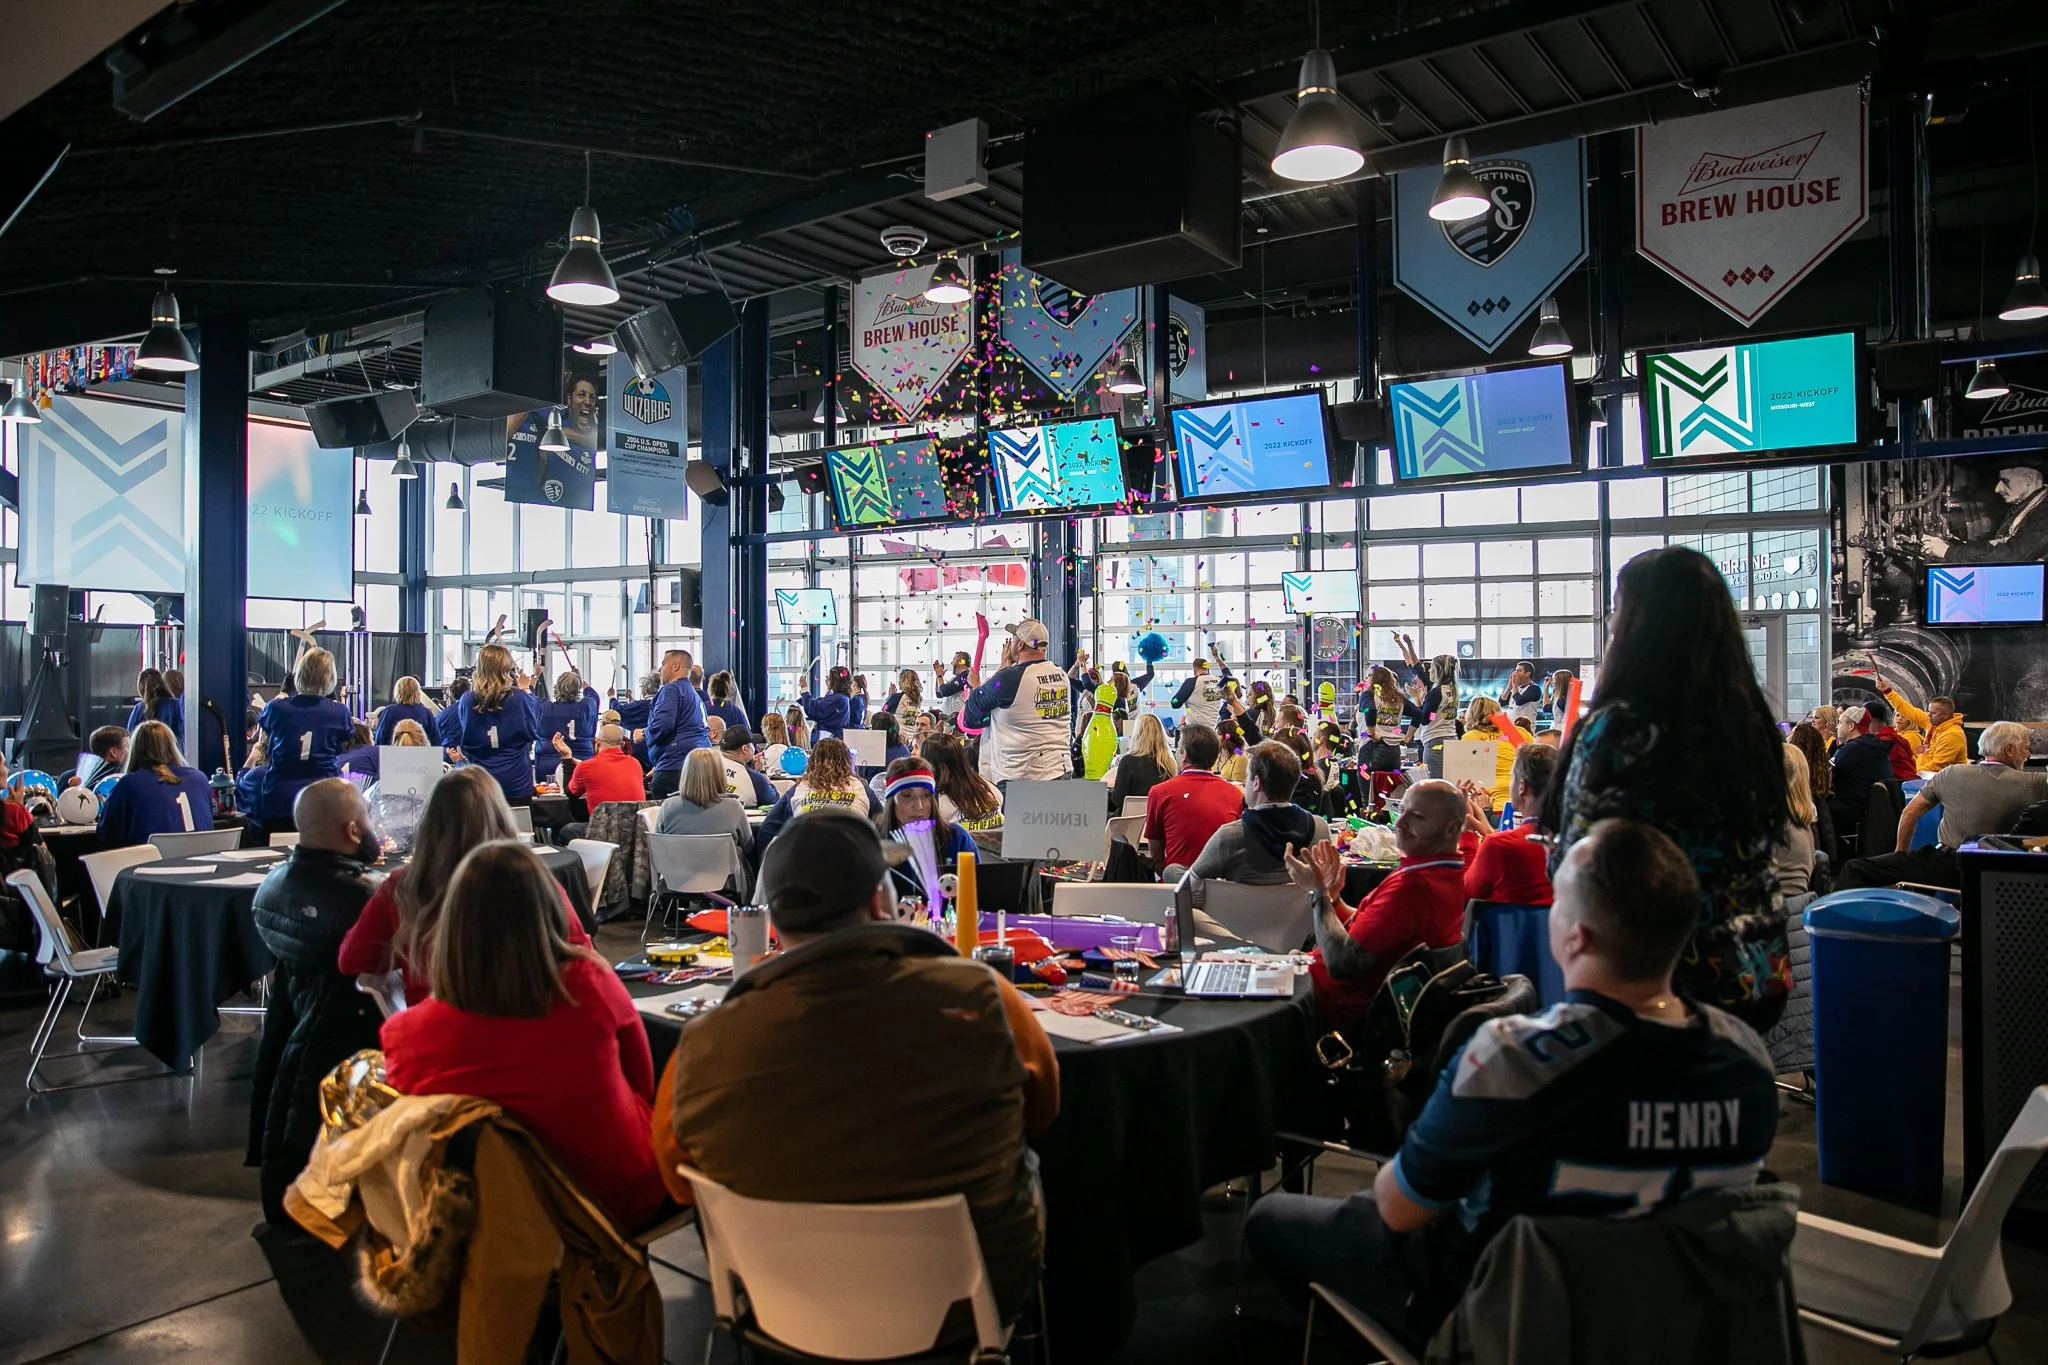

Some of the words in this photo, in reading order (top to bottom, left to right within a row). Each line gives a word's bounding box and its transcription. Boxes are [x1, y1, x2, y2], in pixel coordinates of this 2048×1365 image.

[1474, 171, 1526, 183] RTING
[1689, 152, 1810, 183] Budweiser
[1661, 193, 1737, 226] BREW
[1746, 177, 1841, 214] HOUSE
[864, 324, 904, 348] BREW
[909, 315, 959, 340] HOUSE
[1770, 391, 1793, 401] 2022
[1796, 387, 1839, 398] KICKOFF
[624, 394, 671, 424] WIZARDS
[1770, 401, 1815, 411] MISSOURI-WEST
[1497, 417, 1516, 426] 2022
[1519, 413, 1553, 423] KICKOFF
[624, 442, 637, 450] CUP
[636, 445, 670, 455] CHAMPIONS
[626, 436, 640, 444] 2004
[640, 438, 652, 446] U.S.
[652, 440, 668, 448] OPEN
[1264, 441, 1281, 450] 2022
[1283, 438, 1313, 448] KICKOFF
[248, 504, 268, 516] 22
[274, 507, 333, 521] KICKOFF
[1037, 675, 1049, 685] THE
[1049, 673, 1063, 684] PACK
[487, 725, 500, 749] 1
[567, 719, 577, 740] 1
[300, 731, 313, 761] 1
[176, 791, 195, 832] 1
[1627, 1098, 1741, 1149] HENRY
